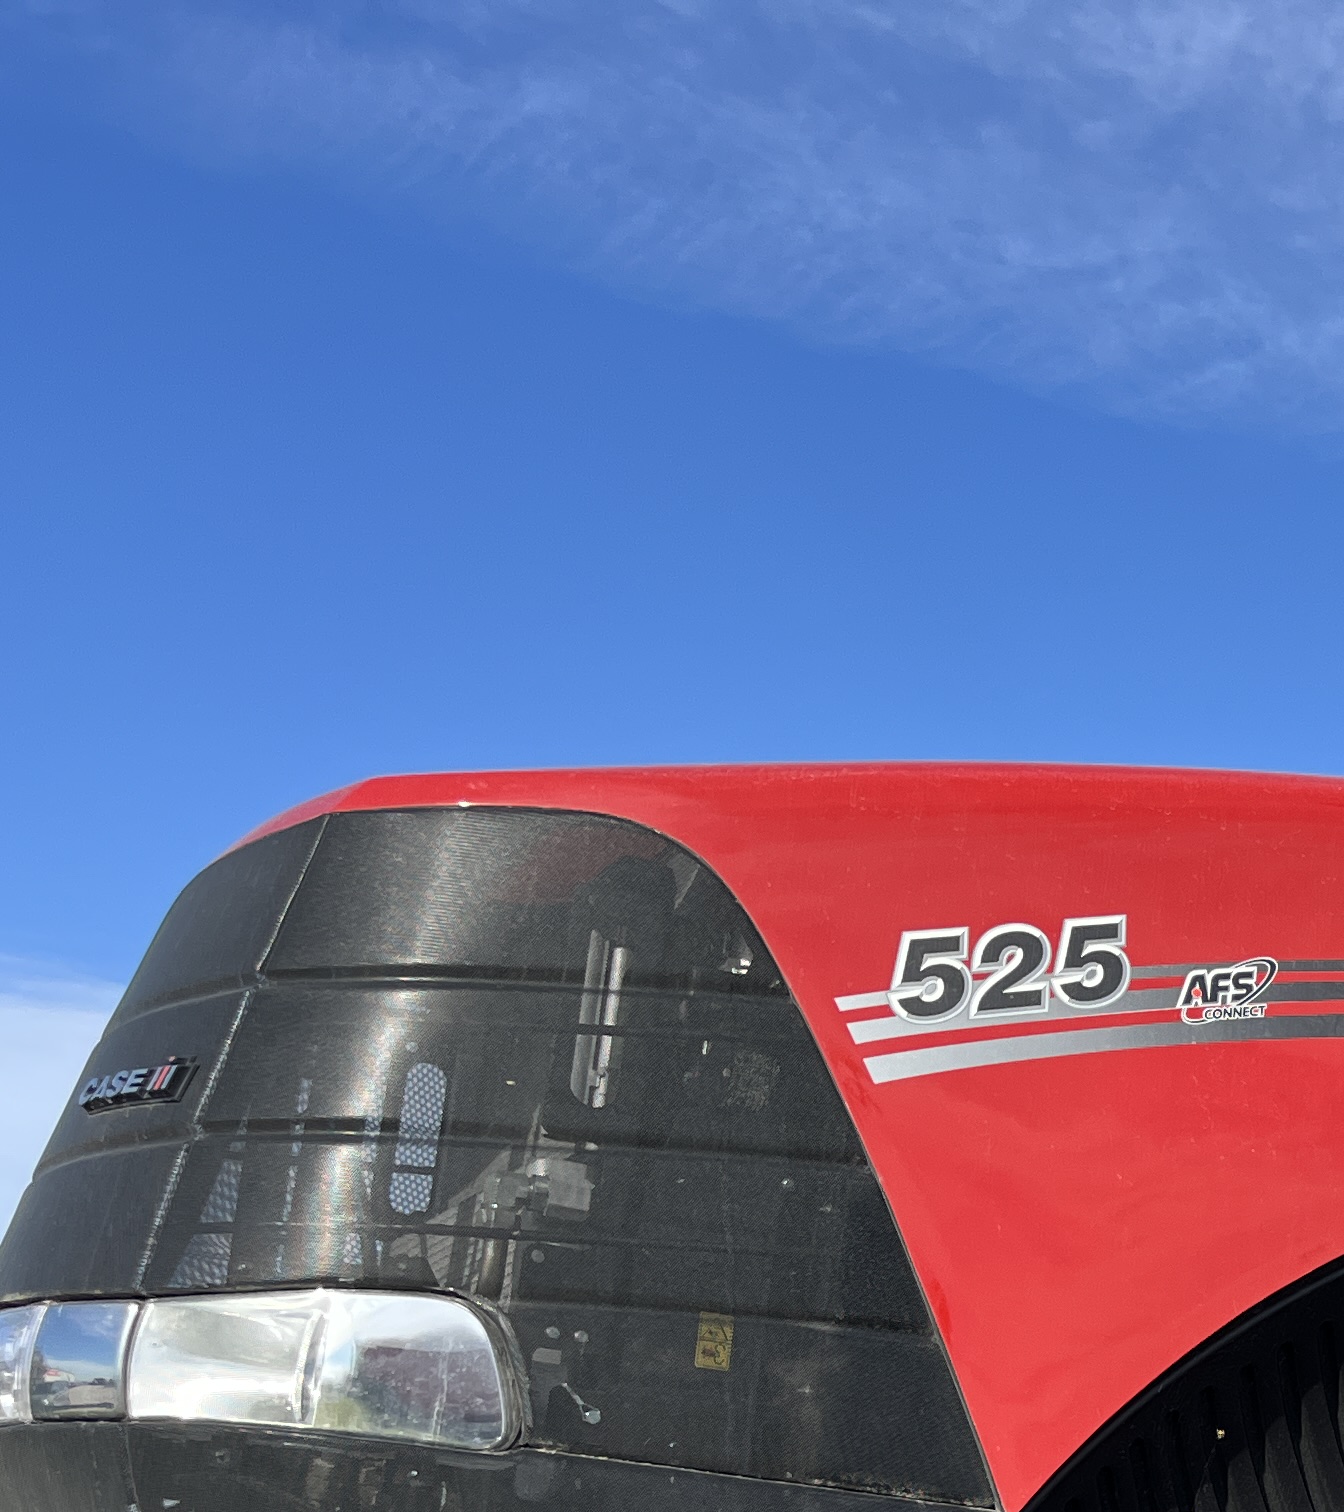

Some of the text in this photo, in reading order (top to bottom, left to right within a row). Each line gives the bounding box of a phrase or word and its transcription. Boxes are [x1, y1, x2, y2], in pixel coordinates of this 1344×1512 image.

[888, 915, 1131, 1024] 525
[1178, 966, 1258, 1006] AFS
[1202, 1003, 1266, 1020] CONNECT
[79, 1067, 148, 1105] CASE
